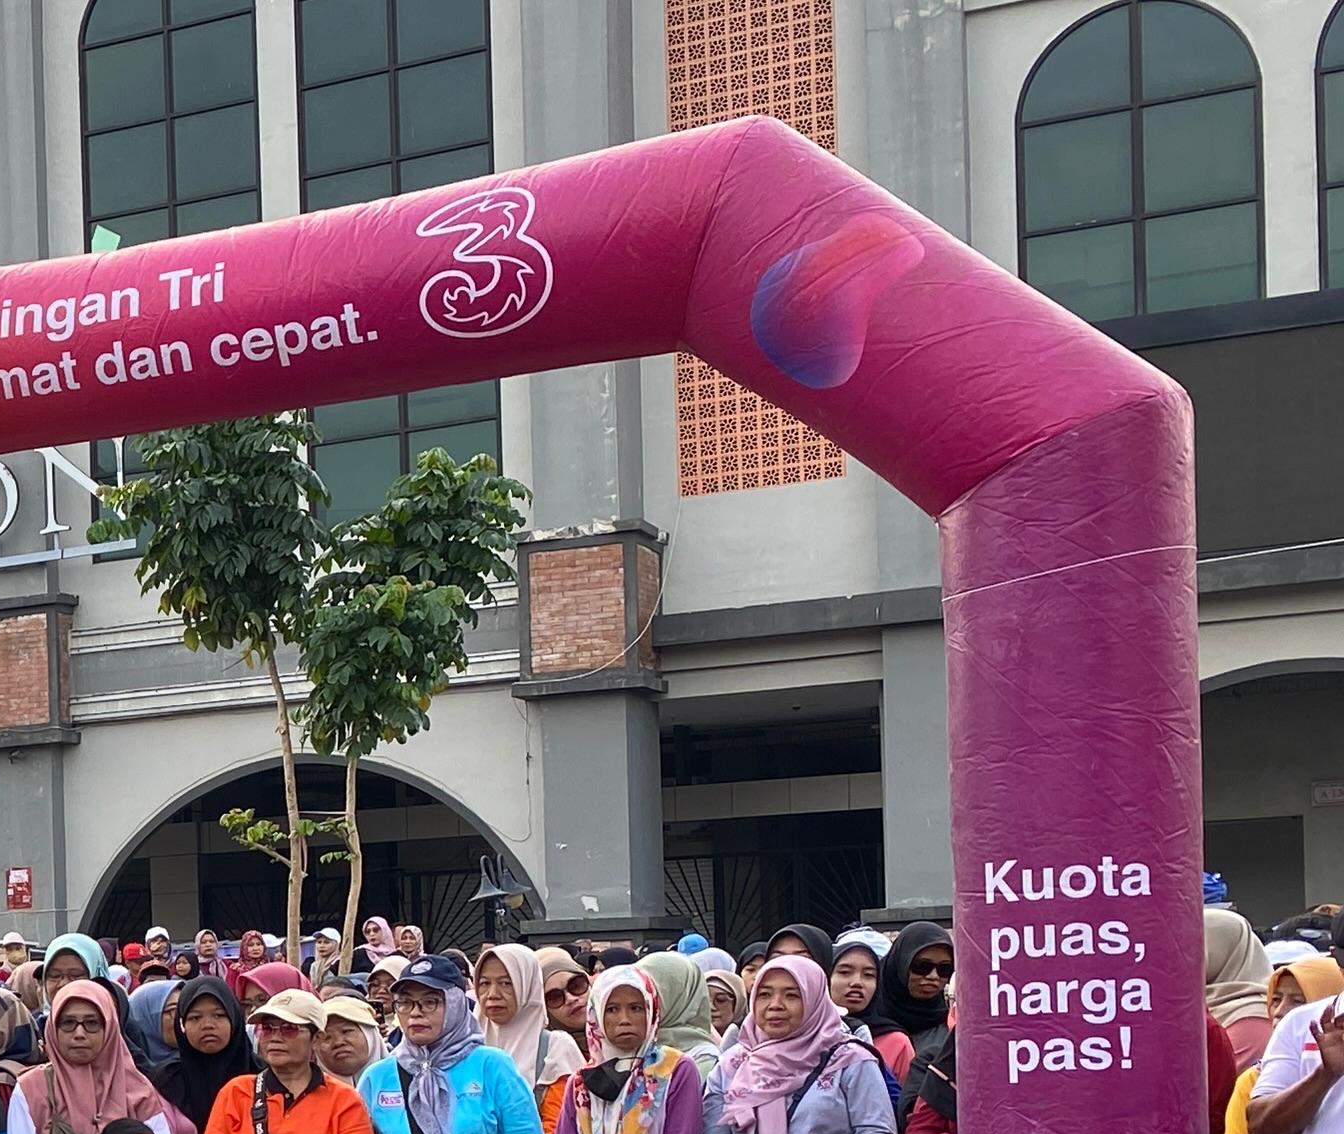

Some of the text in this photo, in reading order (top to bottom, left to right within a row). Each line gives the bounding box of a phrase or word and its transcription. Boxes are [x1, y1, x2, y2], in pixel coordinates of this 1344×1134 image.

[159, 262, 226, 310] Tri
[95, 339, 192, 388] dan
[212, 304, 378, 374] cepat.
[984, 855, 1152, 904] Kuota
[990, 918, 1146, 971] puas,
[989, 974, 1153, 1025] harga
[1007, 1026, 1134, 1084] pas!
